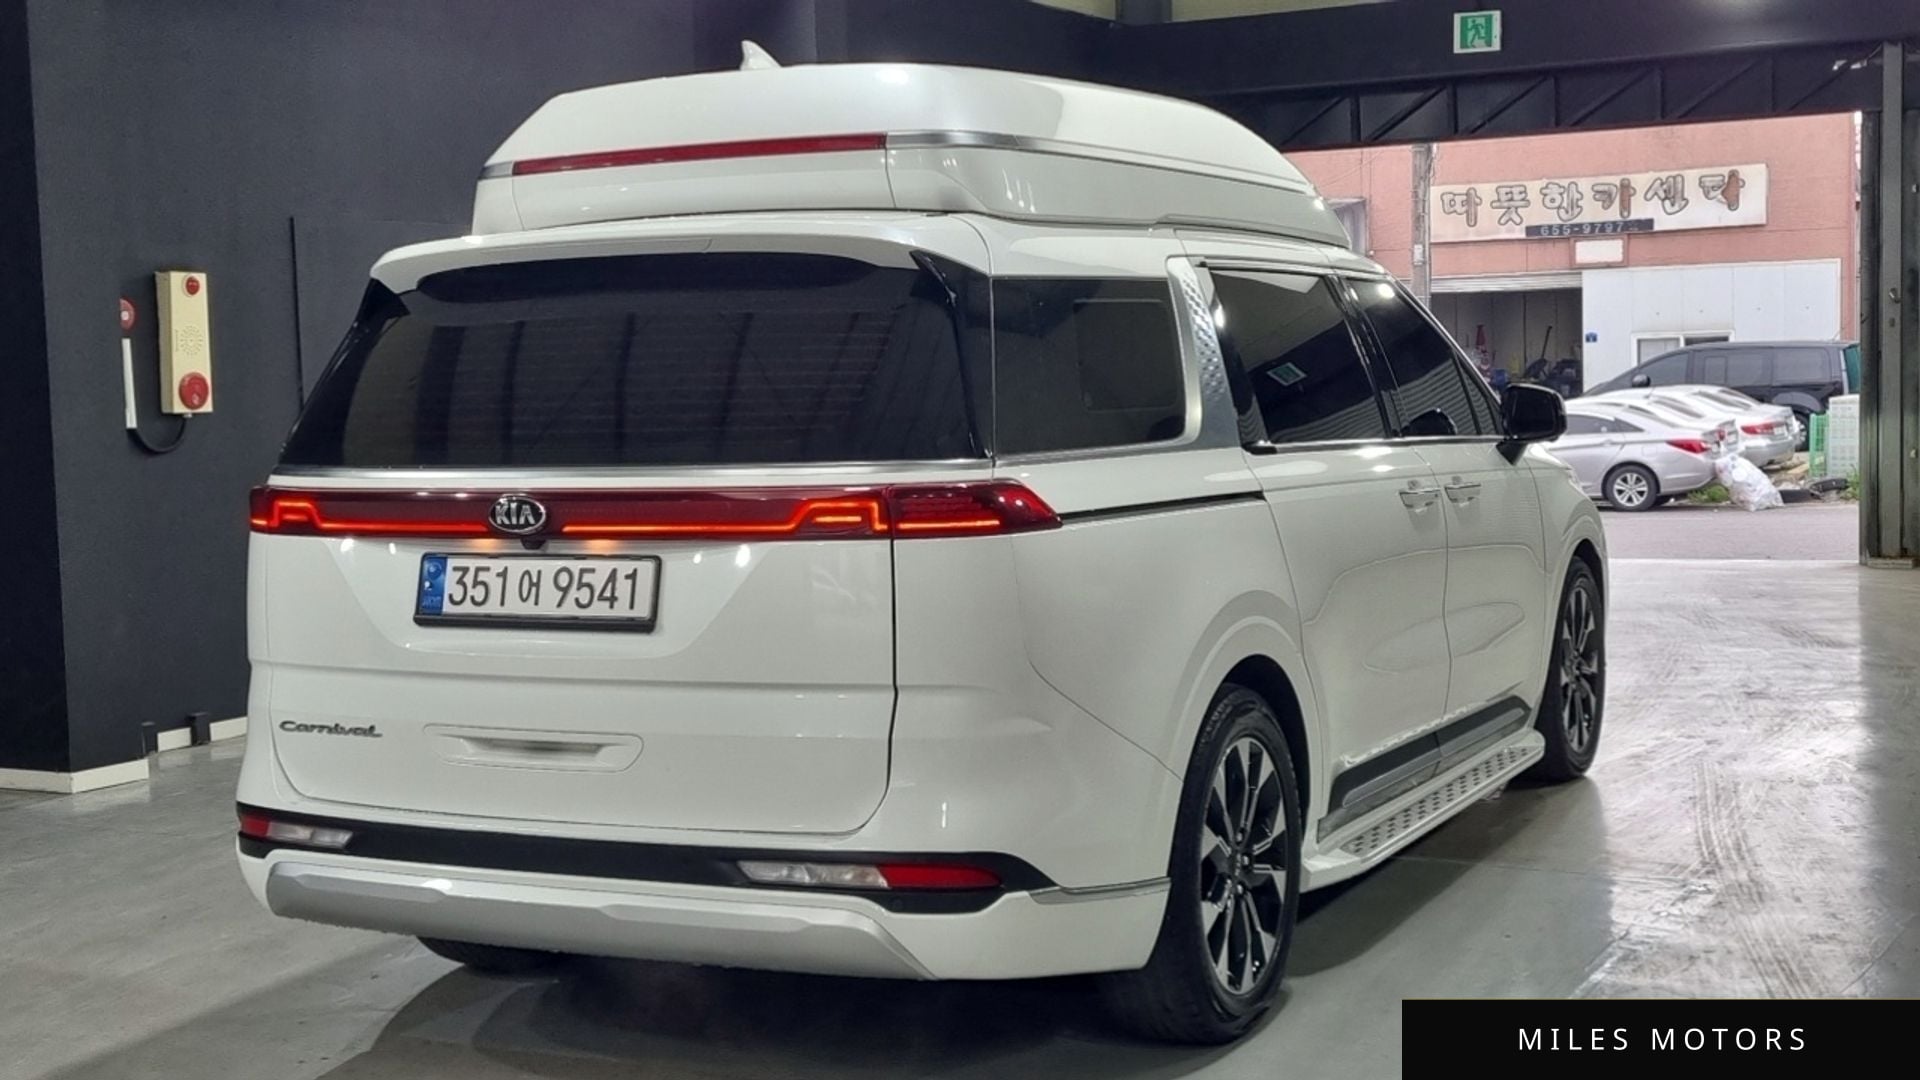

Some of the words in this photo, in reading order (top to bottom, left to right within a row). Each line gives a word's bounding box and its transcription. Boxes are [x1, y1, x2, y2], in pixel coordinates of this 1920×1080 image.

[1540, 221, 1624, 236] 655-9797
[495, 502, 536, 525] KIA
[448, 566, 509, 607] 351
[518, 570, 542, 606] 어
[553, 566, 637, 610] 9541
[279, 720, 383, 738] Carnival
